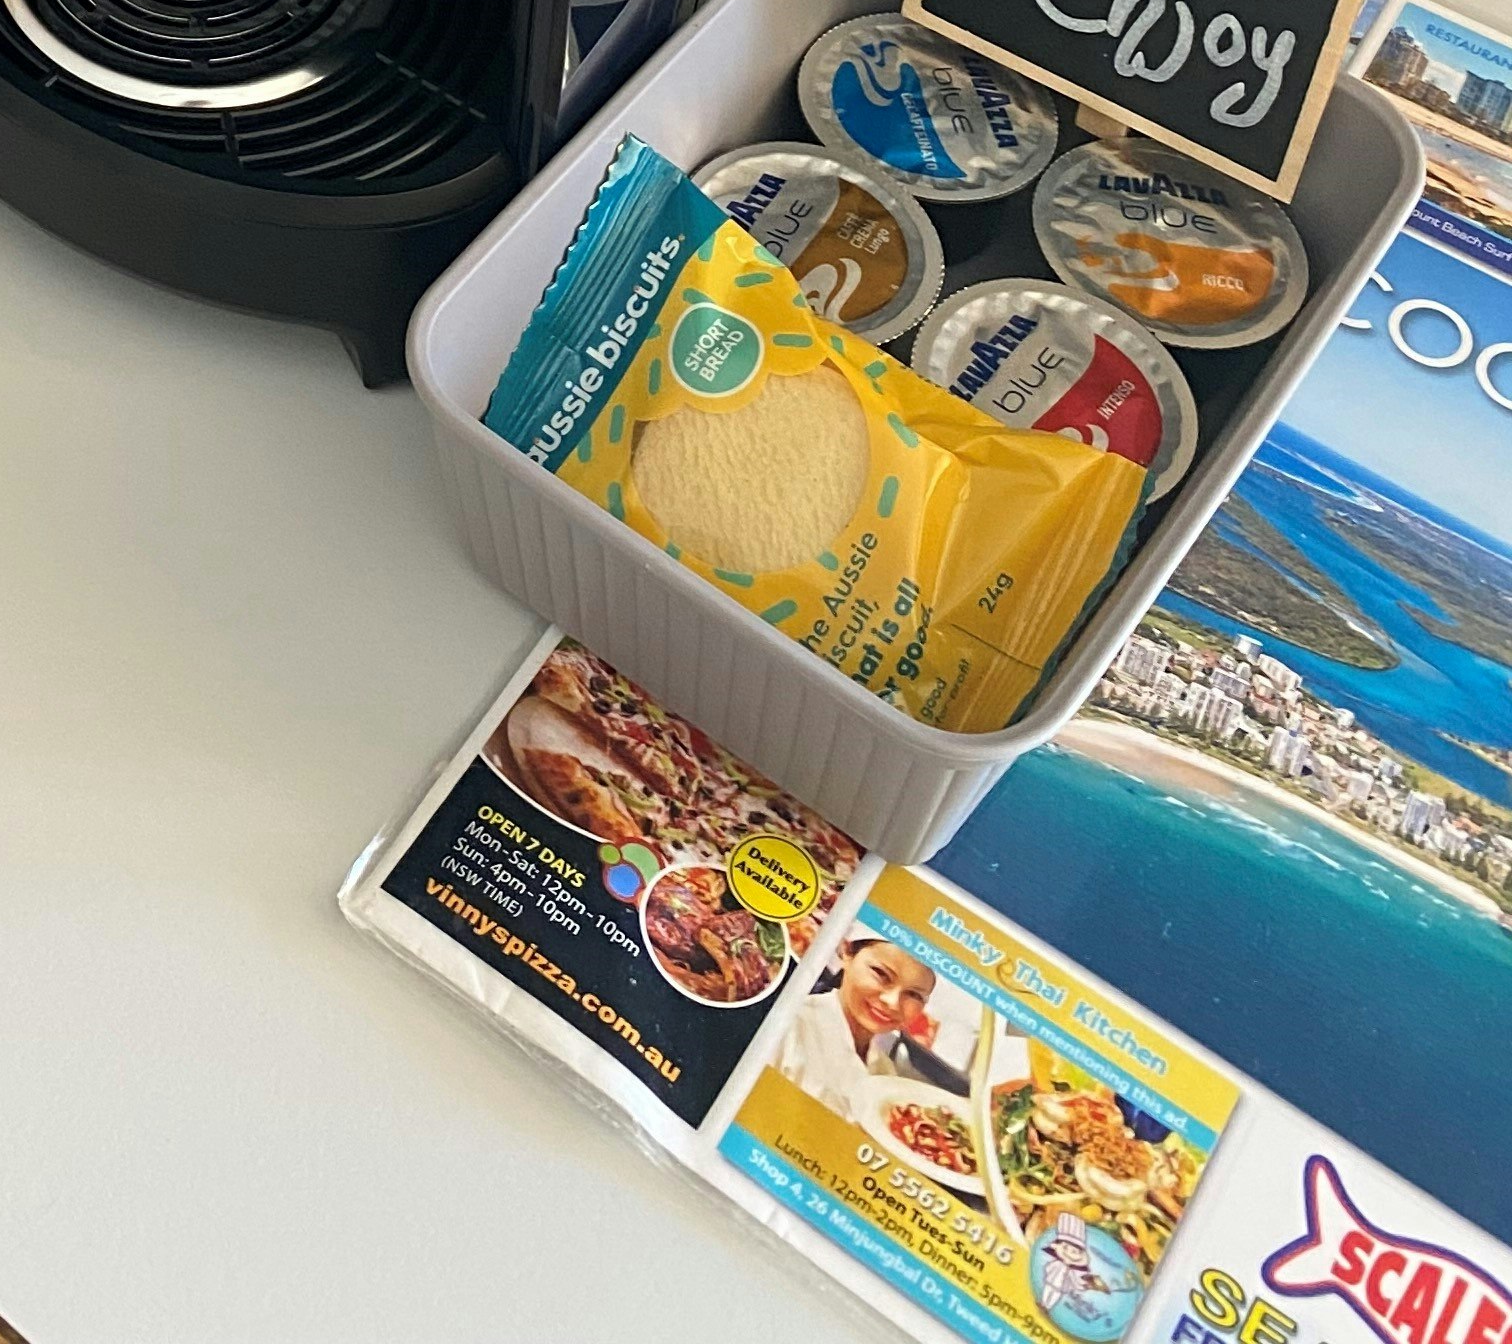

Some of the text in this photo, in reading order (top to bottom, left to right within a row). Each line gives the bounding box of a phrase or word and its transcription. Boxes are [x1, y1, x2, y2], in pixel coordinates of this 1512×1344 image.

[932, 67, 974, 135] blue
[964, 55, 1019, 149] LAVAZZA
[725, 172, 787, 232] AZZA
[1098, 172, 1229, 207] LAVAZZA
[1120, 200, 1218, 234] blue
[850, 219, 879, 249] CREMA
[865, 228, 890, 254] Lungo
[1441, 221, 1482, 248] Beach
[1483, 242, 1512, 262] Surf
[1202, 273, 1244, 291] RICCO
[684, 318, 729, 372] SHORT
[699, 330, 744, 382] BREAD
[949, 314, 1038, 402] LAVAZZA
[992, 346, 1065, 414] blue
[1097, 381, 1136, 420] INTENSO
[823, 532, 879, 618] Aussie
[978, 573, 1014, 614] 24g
[871, 618, 899, 645] is
[894, 577, 920, 616] all
[453, 837, 490, 868] Sun:
[478, 805, 586, 888] OPEN 7 DAYS
[748, 846, 811, 893] Delivery
[440, 855, 524, 917] (NSW TIME)
[734, 860, 803, 909] Available
[424, 874, 681, 1085] vinnyspizza.com.au
[929, 906, 1168, 1077] Minky Thai Kitchen
[880, 918, 913, 948] 10%
[914, 939, 996, 1000] DISCOUNT
[995, 994, 1038, 1030] when
[1039, 1023, 1131, 1094] mentioning
[1131, 1086, 1163, 1115] this
[856, 1143, 1014, 1265] 07 5562 5416
[862, 1176, 986, 1272] Open Tues-Sun
[748, 1147, 789, 1186] Shop
[805, 1192, 828, 1216] 26
[828, 1208, 922, 1284] Minjungbal
[947, 1293, 1004, 1343] Tweed
[774, 1134, 826, 1181] Lunch:
[979, 1283, 1060, 1344] 5pm-9pm
[1331, 1230, 1512, 1344] SCALE
